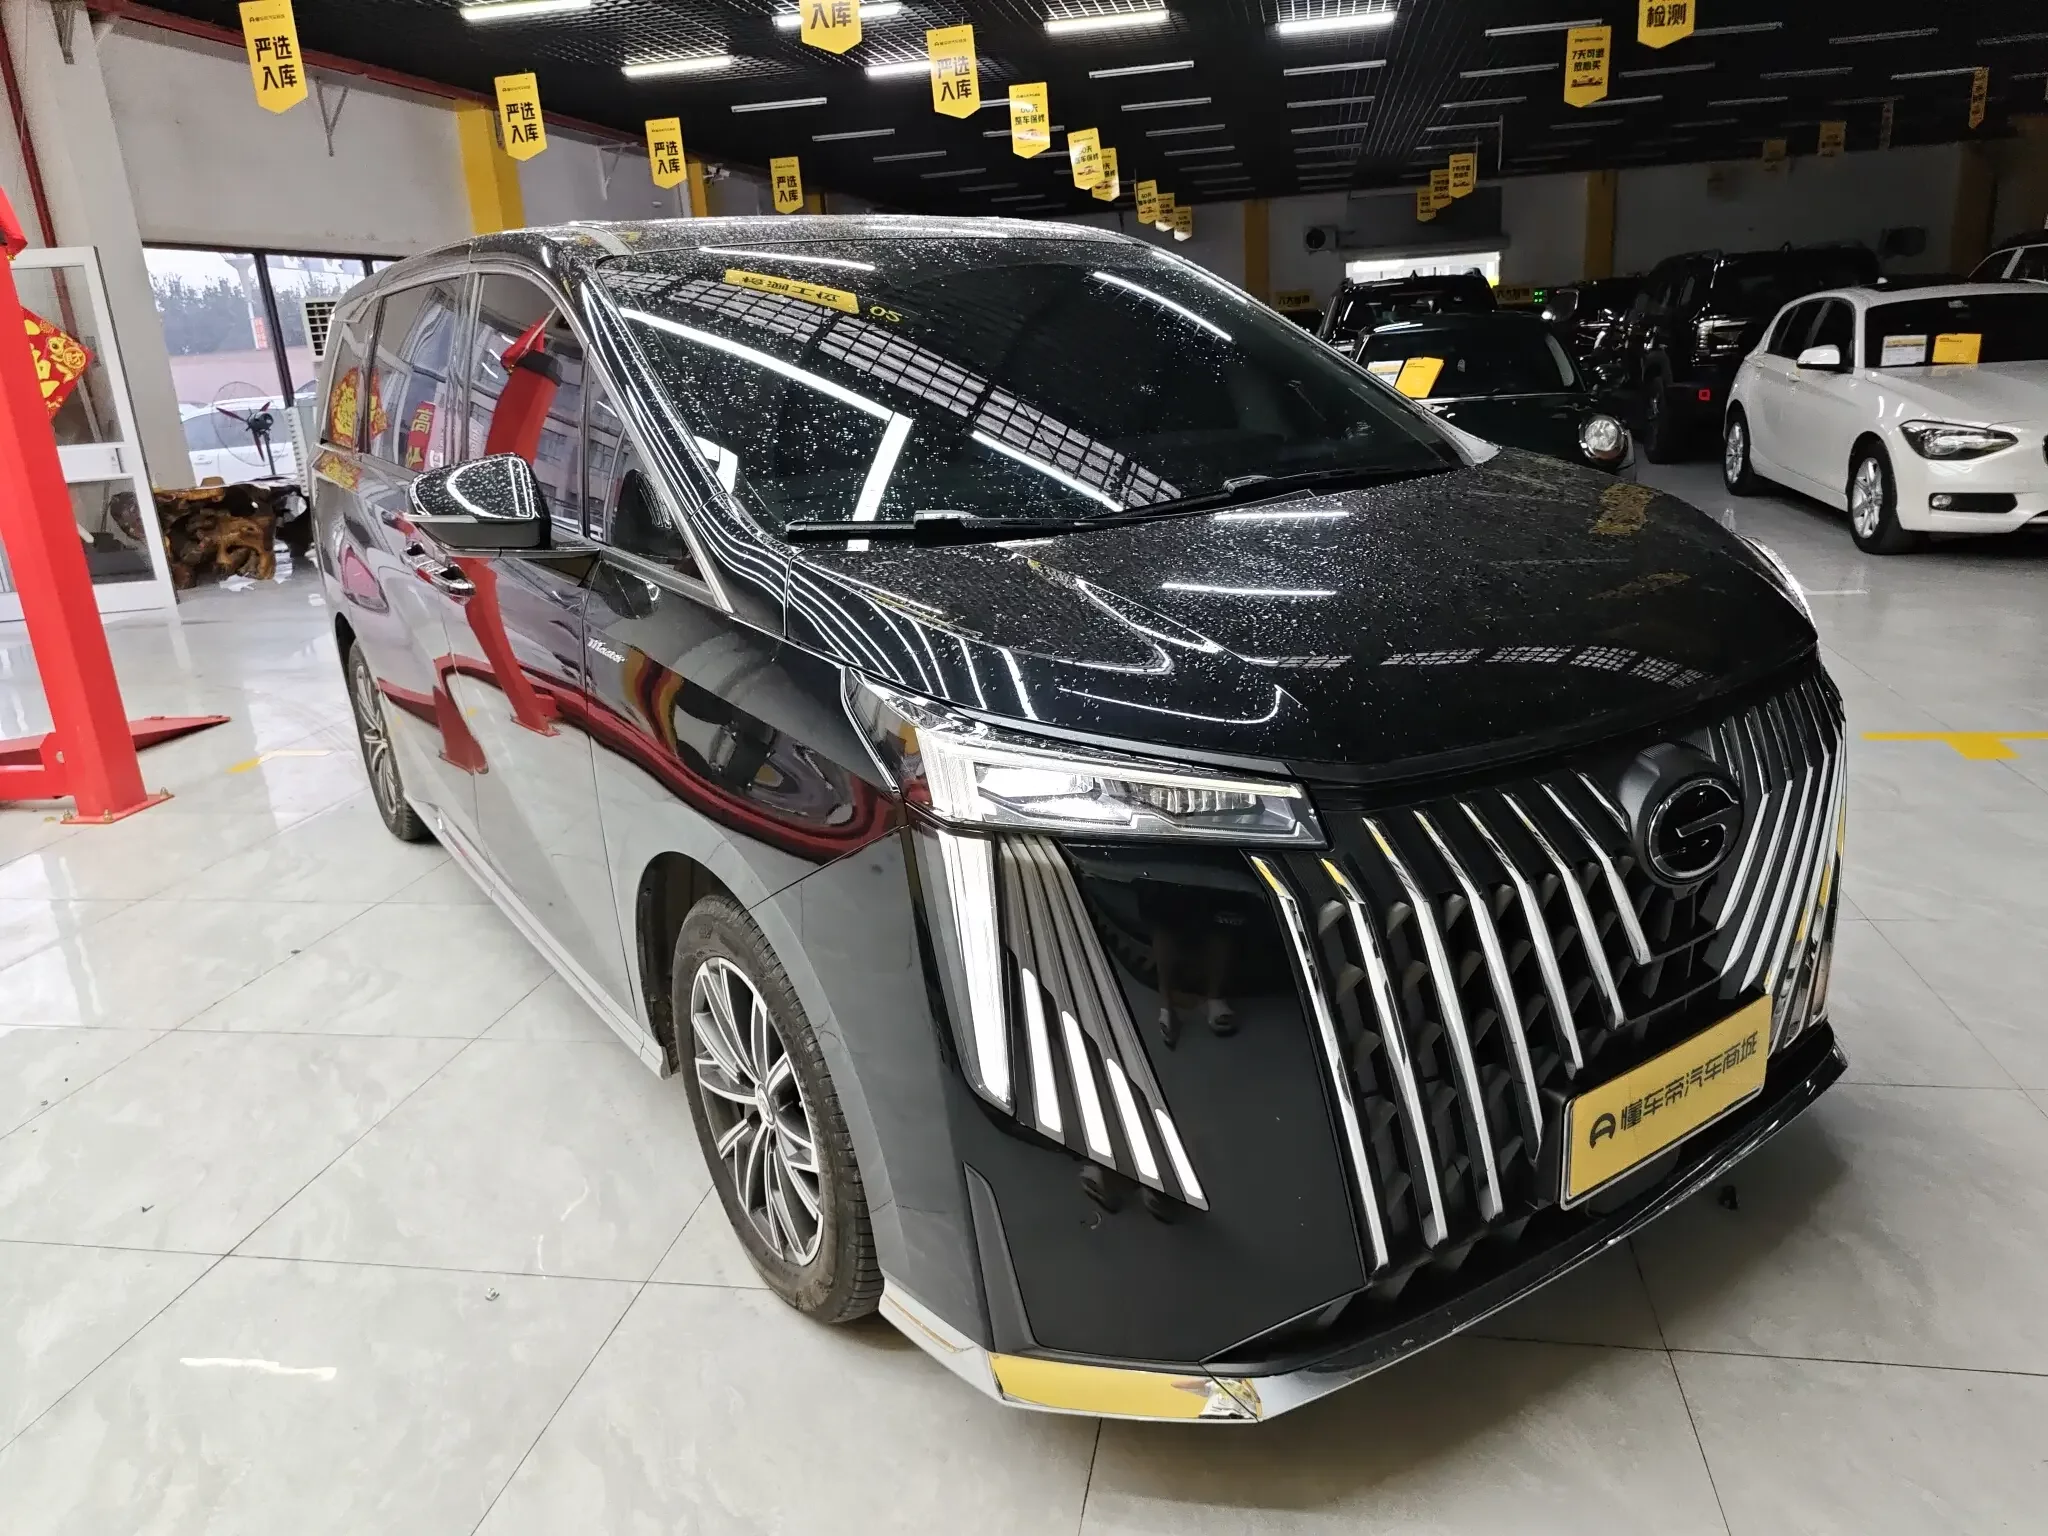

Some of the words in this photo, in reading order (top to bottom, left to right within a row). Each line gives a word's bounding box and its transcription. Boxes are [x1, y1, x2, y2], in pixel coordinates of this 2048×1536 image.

[810, 1, 852, 30] 入库
[1647, 3, 1687, 28] 检测
[254, 35, 293, 63] 严选
[262, 64, 298, 91] 入库
[937, 55, 971, 79] 严选
[941, 79, 972, 102] 入库
[505, 102, 536, 123] 严选
[511, 123, 539, 144] 入库
[654, 140, 679, 158] 严选
[657, 157, 681, 175] 入库
[776, 175, 798, 189] 严选
[779, 189, 799, 203] 入库
[1620, 1030, 1759, 1132] 懂车帝汽车商城
